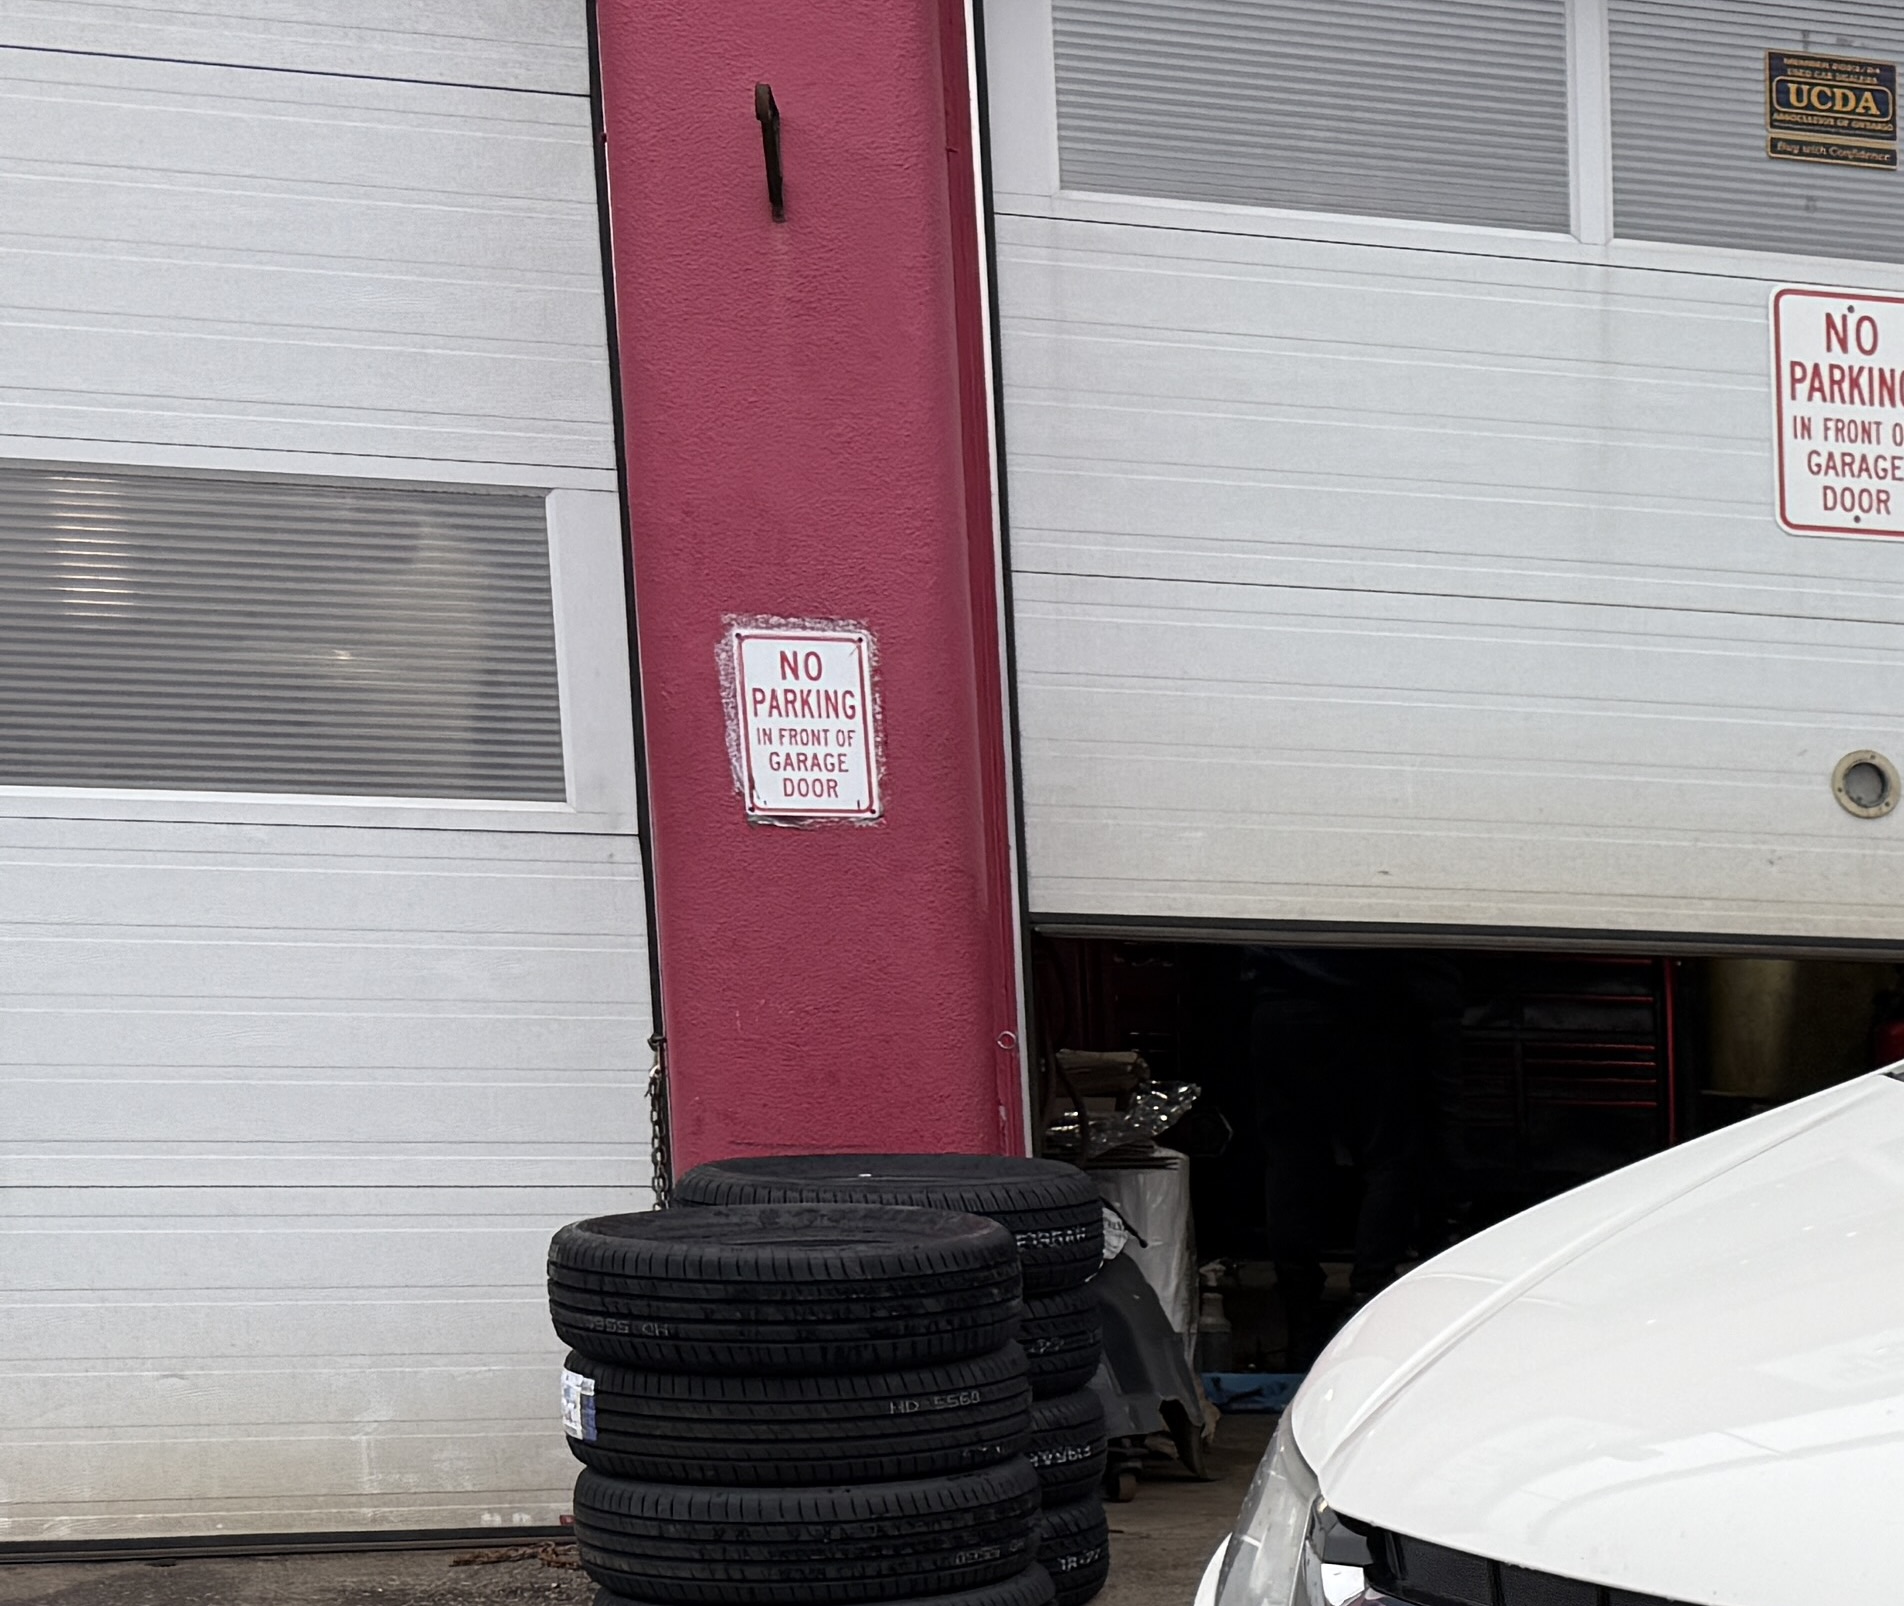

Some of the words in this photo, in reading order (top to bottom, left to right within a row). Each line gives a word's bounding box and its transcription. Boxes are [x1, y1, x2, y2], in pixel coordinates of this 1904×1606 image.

[1787, 82, 1880, 115] UCDA
[1825, 312, 1878, 356] NO
[1793, 415, 1812, 441] IN
[1823, 417, 1882, 446] FRONT
[1807, 449, 1904, 482] GARAGE
[1822, 485, 1891, 516] DOOR
[779, 650, 823, 681] NO
[752, 687, 857, 720] PARKING
[757, 727, 773, 745] IN
[779, 728, 830, 748] FRONT
[836, 729, 857, 748] OF
[768, 752, 849, 773] GARAGE
[783, 778, 839, 798] DOOR
